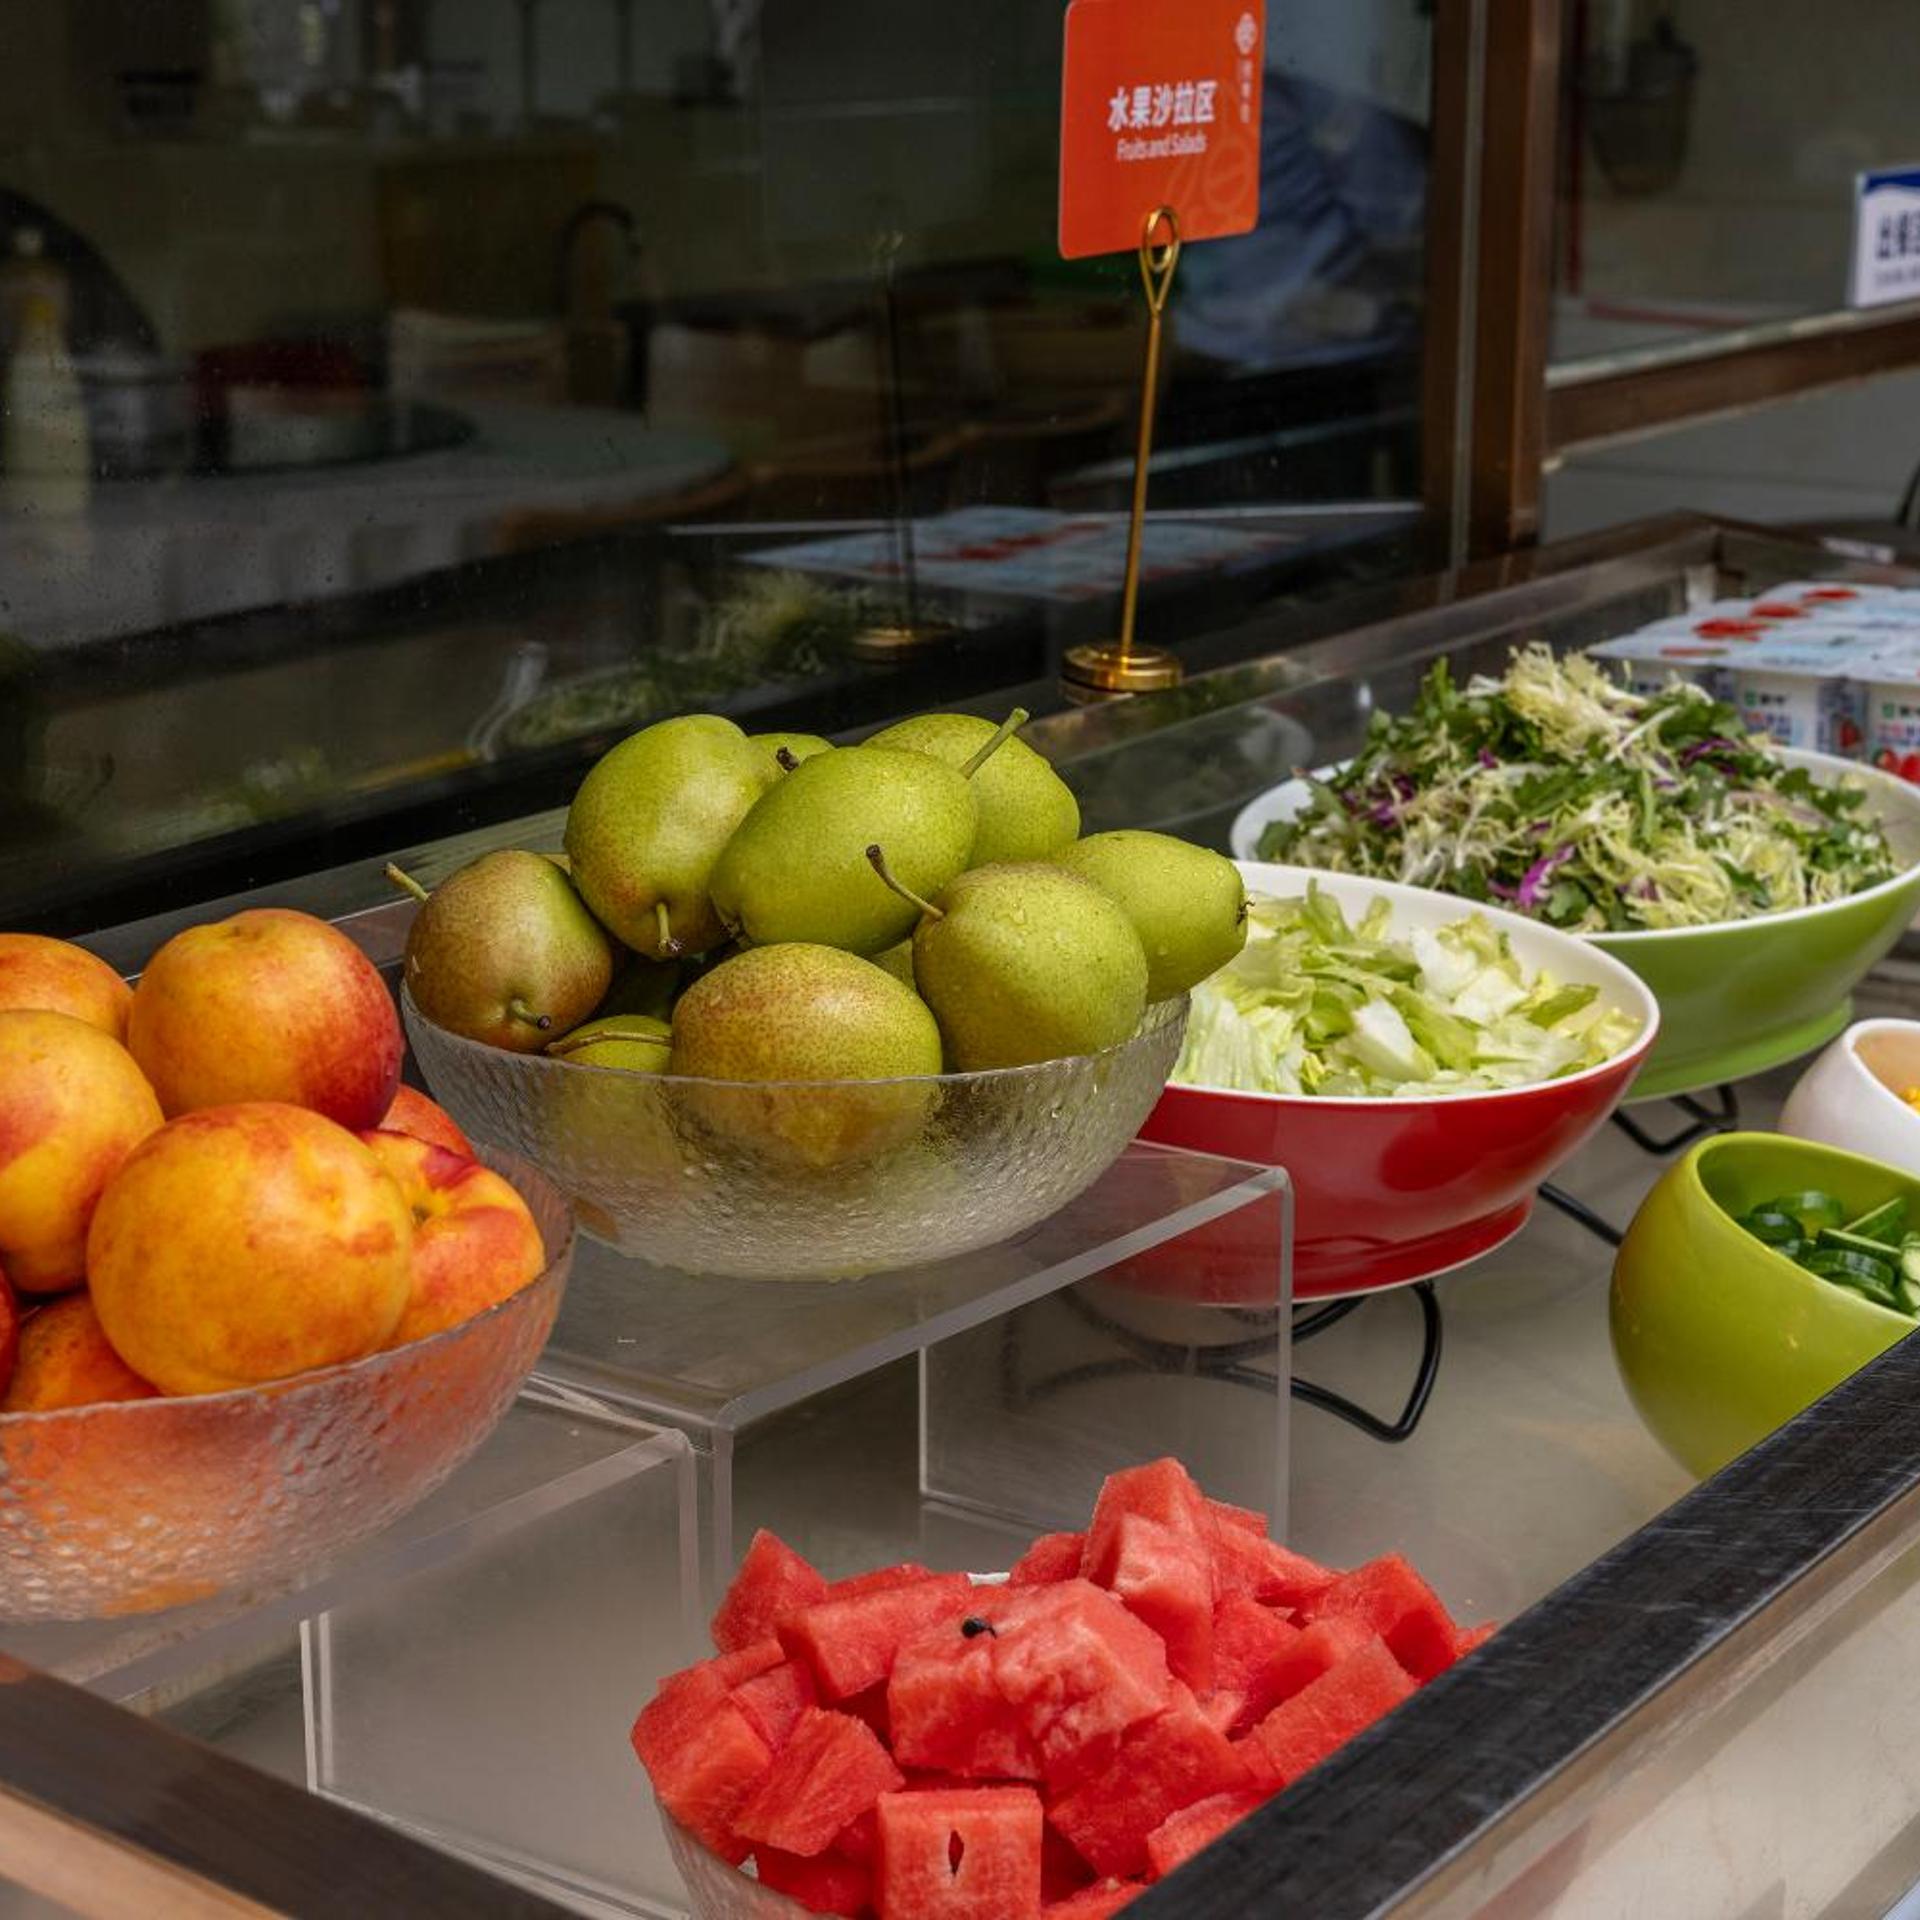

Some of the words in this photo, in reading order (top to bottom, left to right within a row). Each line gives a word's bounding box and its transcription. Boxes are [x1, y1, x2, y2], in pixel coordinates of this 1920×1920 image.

[1108, 80, 1217, 131] 水果沙拉区
[1117, 138, 1146, 160] Fruits
[1147, 135, 1170, 157] and
[1170, 131, 1207, 155] Salads
